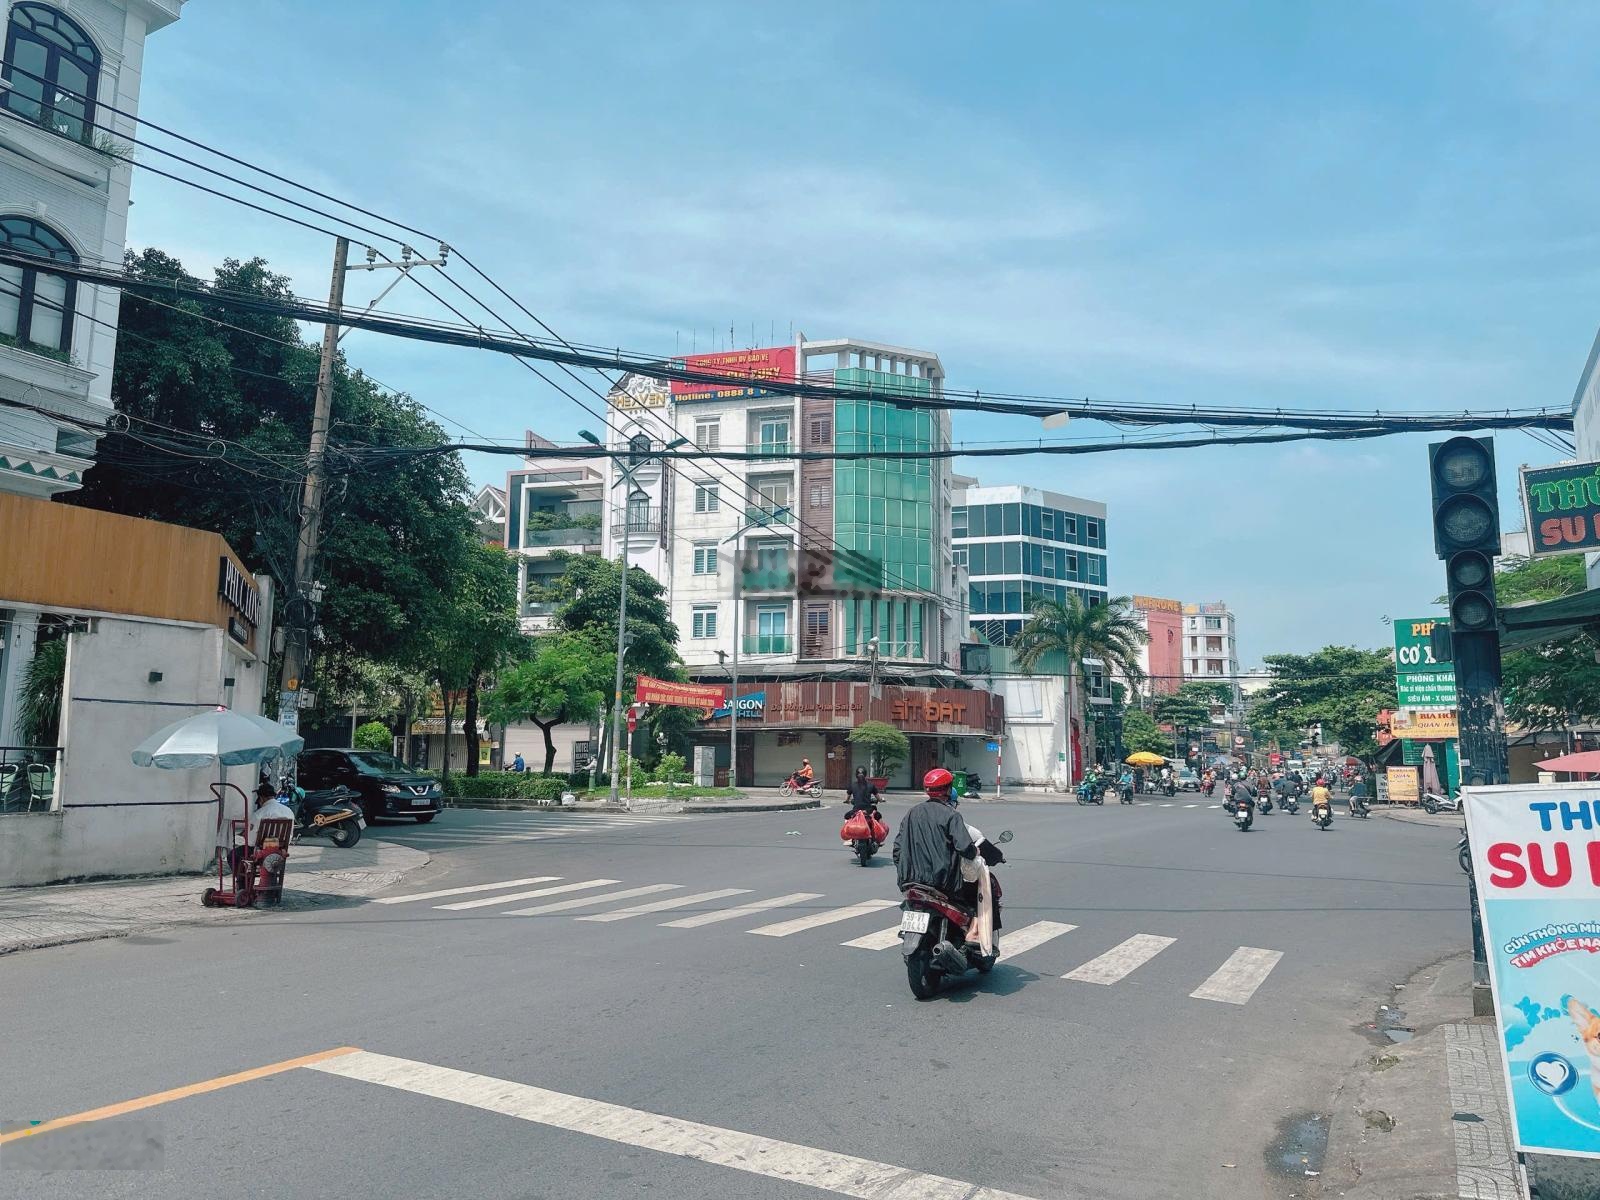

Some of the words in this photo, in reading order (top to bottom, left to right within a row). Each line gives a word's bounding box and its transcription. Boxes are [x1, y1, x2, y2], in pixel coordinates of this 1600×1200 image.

[614, 393, 666, 407] HEAVEN
[717, 388, 744, 398] 0888
[1541, 515, 1586, 545] SU
[1399, 643, 1421, 664] CƠ
[1406, 673, 1435, 682] PHÒNG
[1529, 800, 1600, 831] TH
[1487, 842, 1572, 889] SU
[1504, 935, 1531, 954] CÚN
[1529, 924, 1577, 941] THÔNG
[1511, 950, 1538, 967] TIM
[1579, 938, 1600, 951] MẠ
